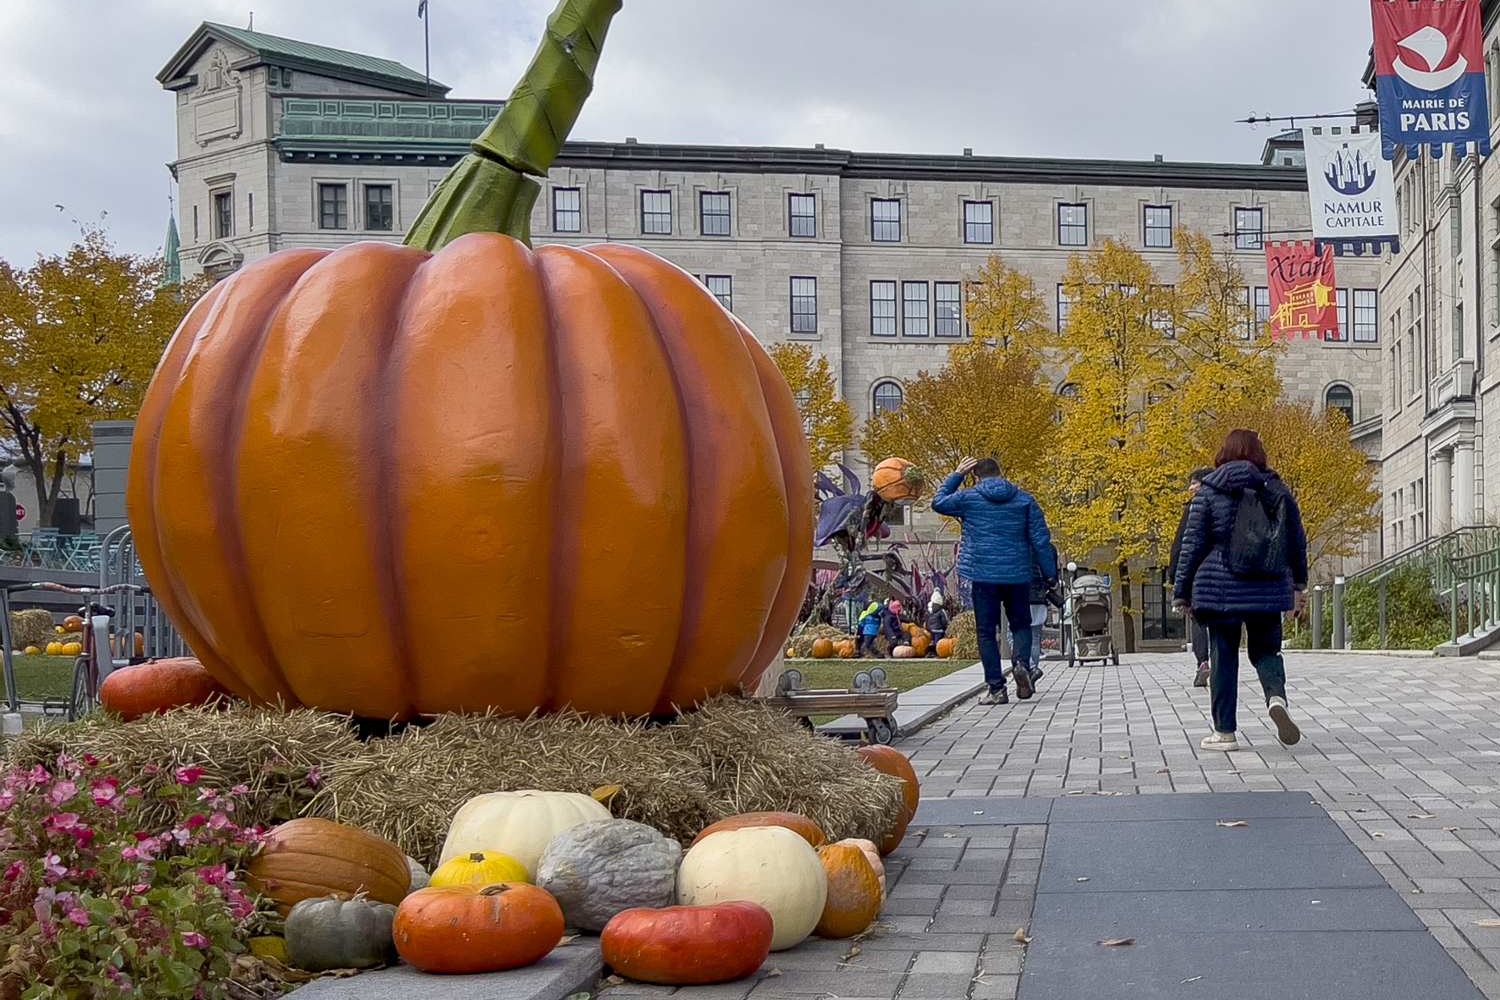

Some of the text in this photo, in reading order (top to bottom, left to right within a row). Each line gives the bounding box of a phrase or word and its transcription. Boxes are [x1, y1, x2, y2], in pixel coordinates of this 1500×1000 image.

[1402, 98, 1465, 110] MAIRIE DE
[1400, 111, 1471, 132] PARIS
[1324, 200, 1383, 214] NAMUR
[1326, 215, 1385, 228] CAPITALE
[1270, 254, 1330, 283] Xi'an
